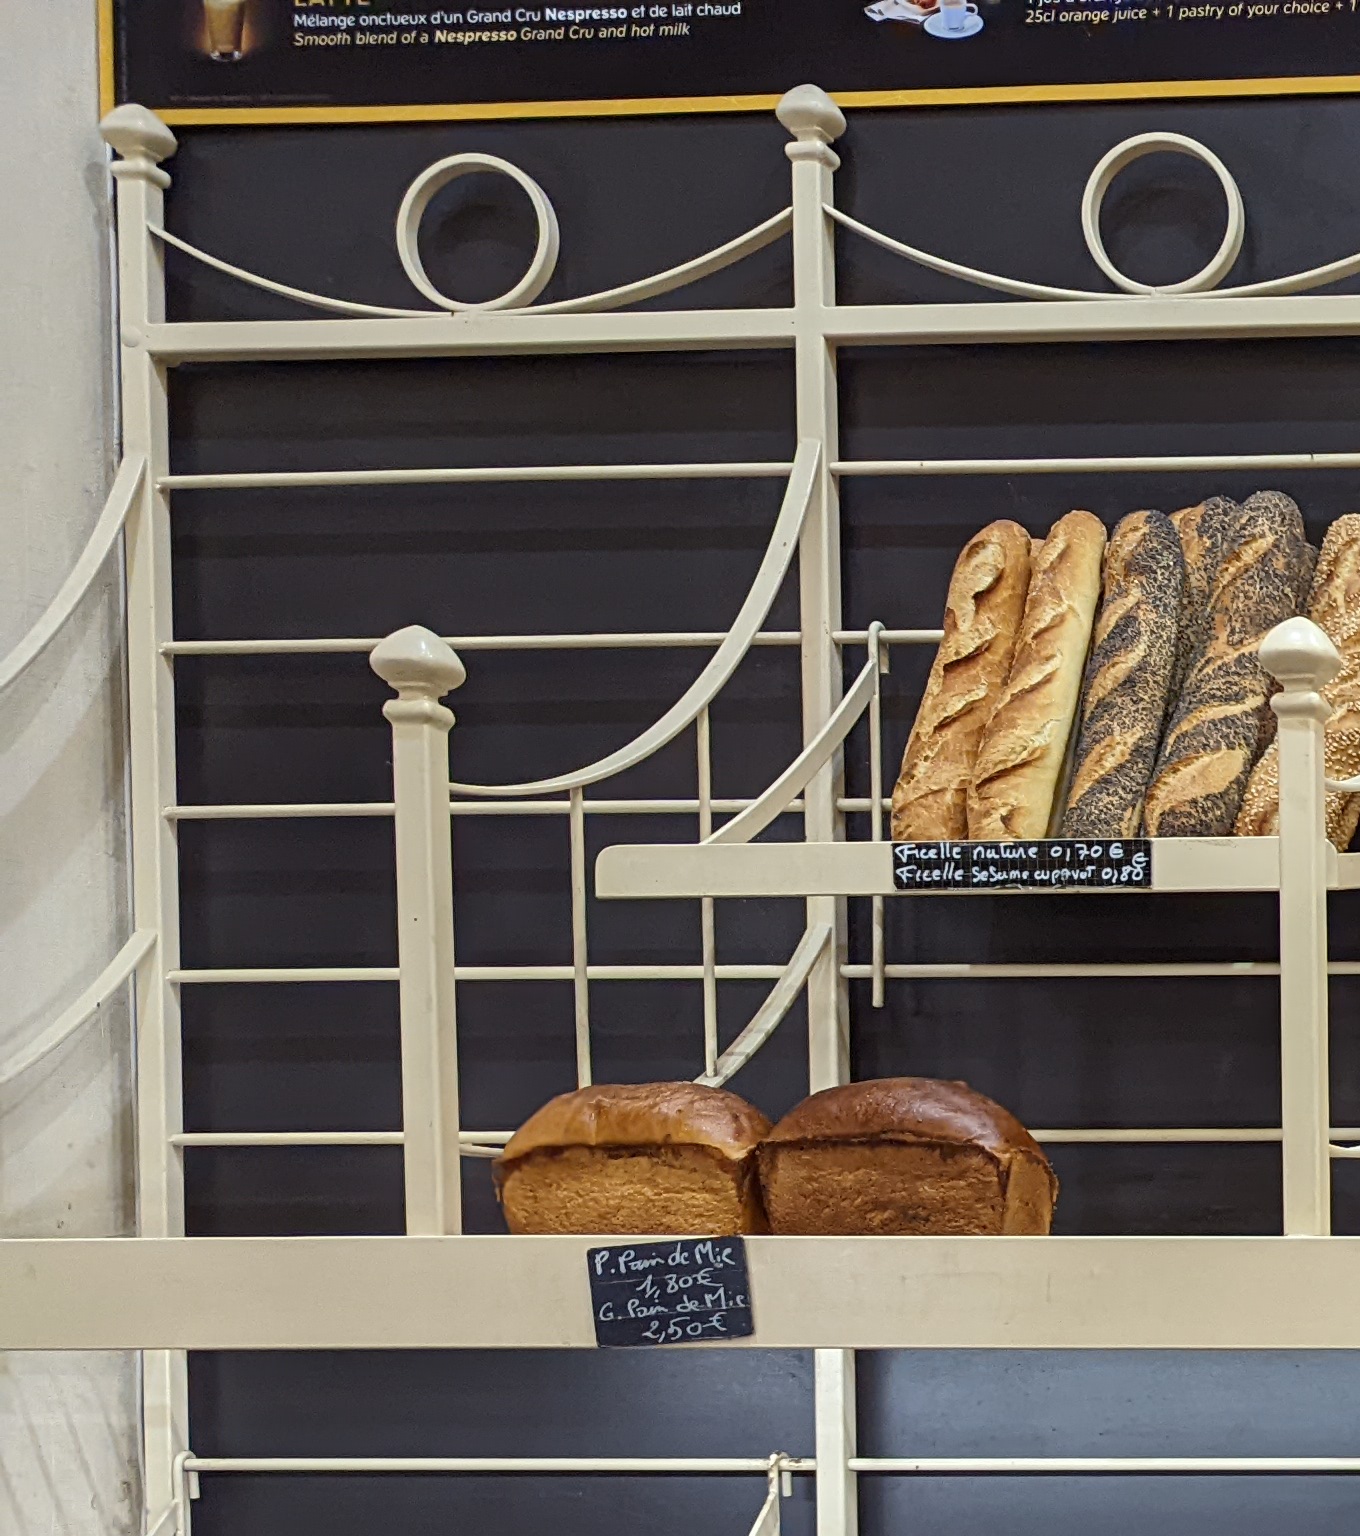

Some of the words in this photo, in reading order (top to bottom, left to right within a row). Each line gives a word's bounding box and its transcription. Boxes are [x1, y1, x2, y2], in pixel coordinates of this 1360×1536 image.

[294, 13, 355, 29] Mélange
[359, 12, 427, 26] onctueux
[431, 11, 463, 24] d'un
[467, 10, 511, 23] Grand
[515, 9, 541, 22] Cru
[545, 7, 627, 23] Nespresso
[632, 6, 645, 18] et
[650, 5, 668, 17] de
[672, 3, 693, 17] lait
[697, 2, 741, 16] chaud
[1025, 9, 1055, 23] 25cl
[1059, 10, 1110, 25] orange
[1112, 7, 1147, 23] juice
[1166, 5, 1173, 18] 1
[1178, 5, 1224, 21] pastry
[1228, 3, 1243, 16] of
[1247, 4, 1279, 18] your
[1283, 1, 1329, 14] choice
[293, 32, 351, 46] Smooth
[355, 30, 397, 44] blend
[401, 30, 416, 44] of
[420, 33, 429, 43] a
[434, 29, 517, 45] Nespresso
[521, 27, 564, 41] Grand
[569, 26, 594, 39] Cru
[598, 24, 627, 39] and
[631, 23, 655, 38] hot
[658, 22, 690, 37] milk
[973, 842, 1038, 860] nature
[1109, 842, 1124, 859] €
[668, 1242, 690, 1266] de
[695, 1241, 736, 1266] Mie
[676, 1294, 700, 1312] de
[704, 1287, 746, 1310] Mie
